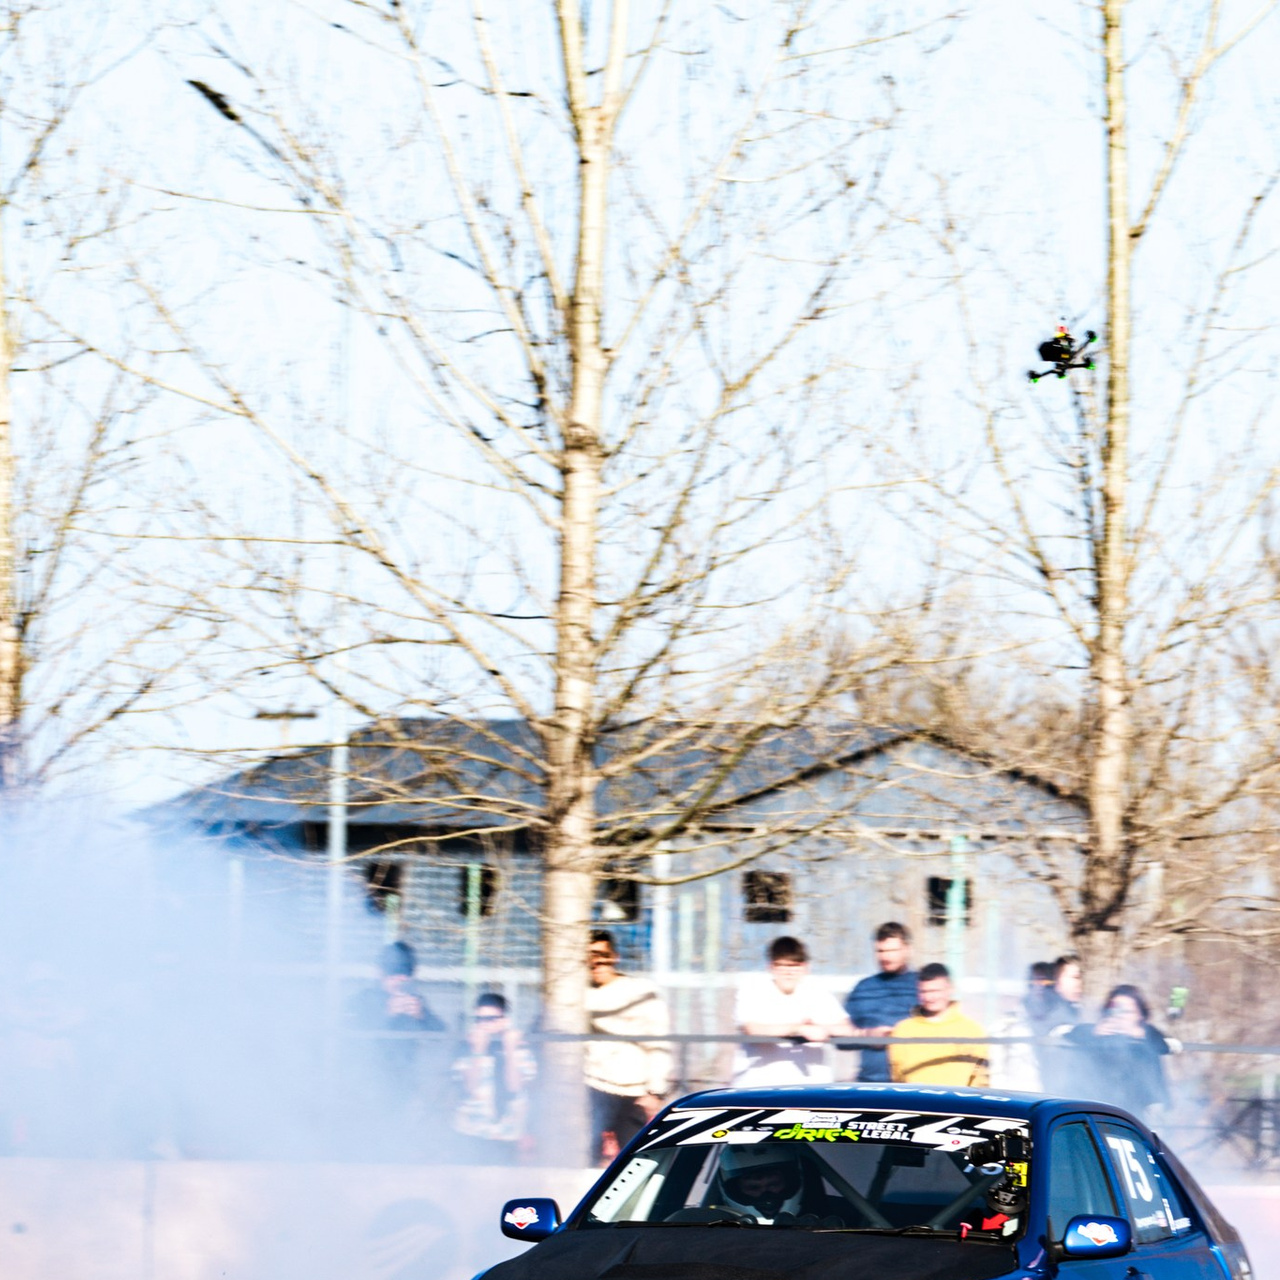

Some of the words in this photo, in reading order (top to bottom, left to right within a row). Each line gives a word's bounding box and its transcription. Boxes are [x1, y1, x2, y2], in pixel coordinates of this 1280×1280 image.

[847, 1121, 908, 1132] STREET
[861, 1129, 911, 1141] LEGAL
[1105, 1136, 1153, 1203] 75
